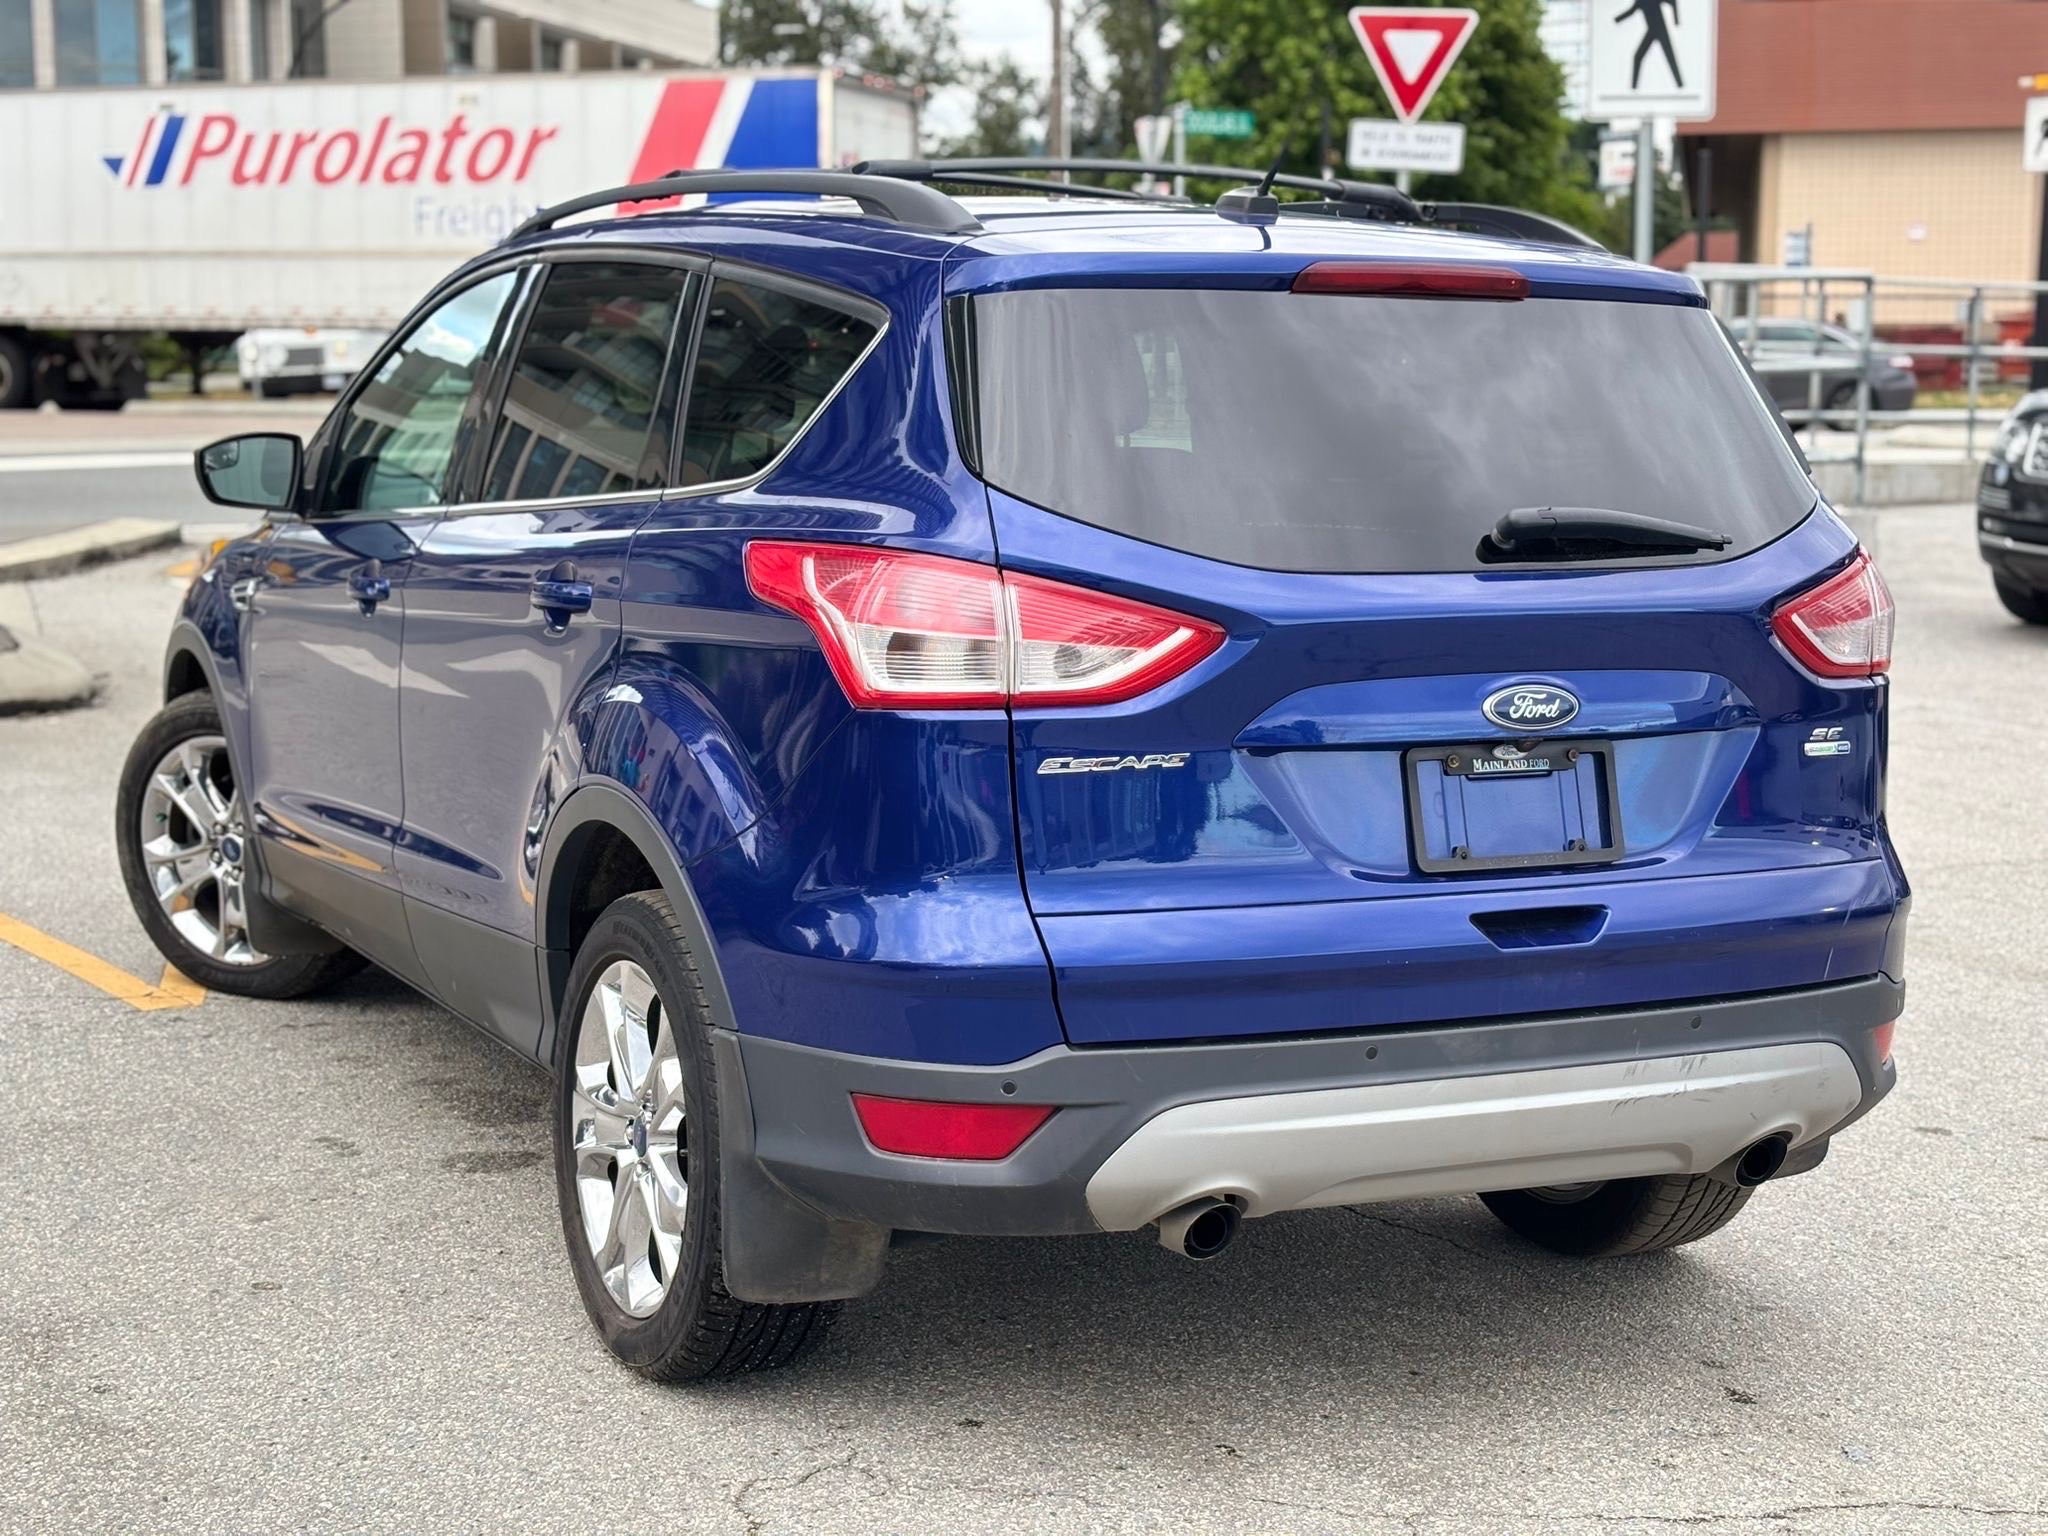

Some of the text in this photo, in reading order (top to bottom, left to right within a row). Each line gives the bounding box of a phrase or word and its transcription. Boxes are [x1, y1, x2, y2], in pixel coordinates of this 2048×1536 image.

[180, 113, 558, 186] Purolator
[415, 195, 532, 246] Freigh
[1509, 692, 1560, 719] Ford
[1810, 726, 1844, 740] SE
[1037, 753, 1190, 774] ESCAPE
[1472, 758, 1550, 772] MAINLAND FORD
